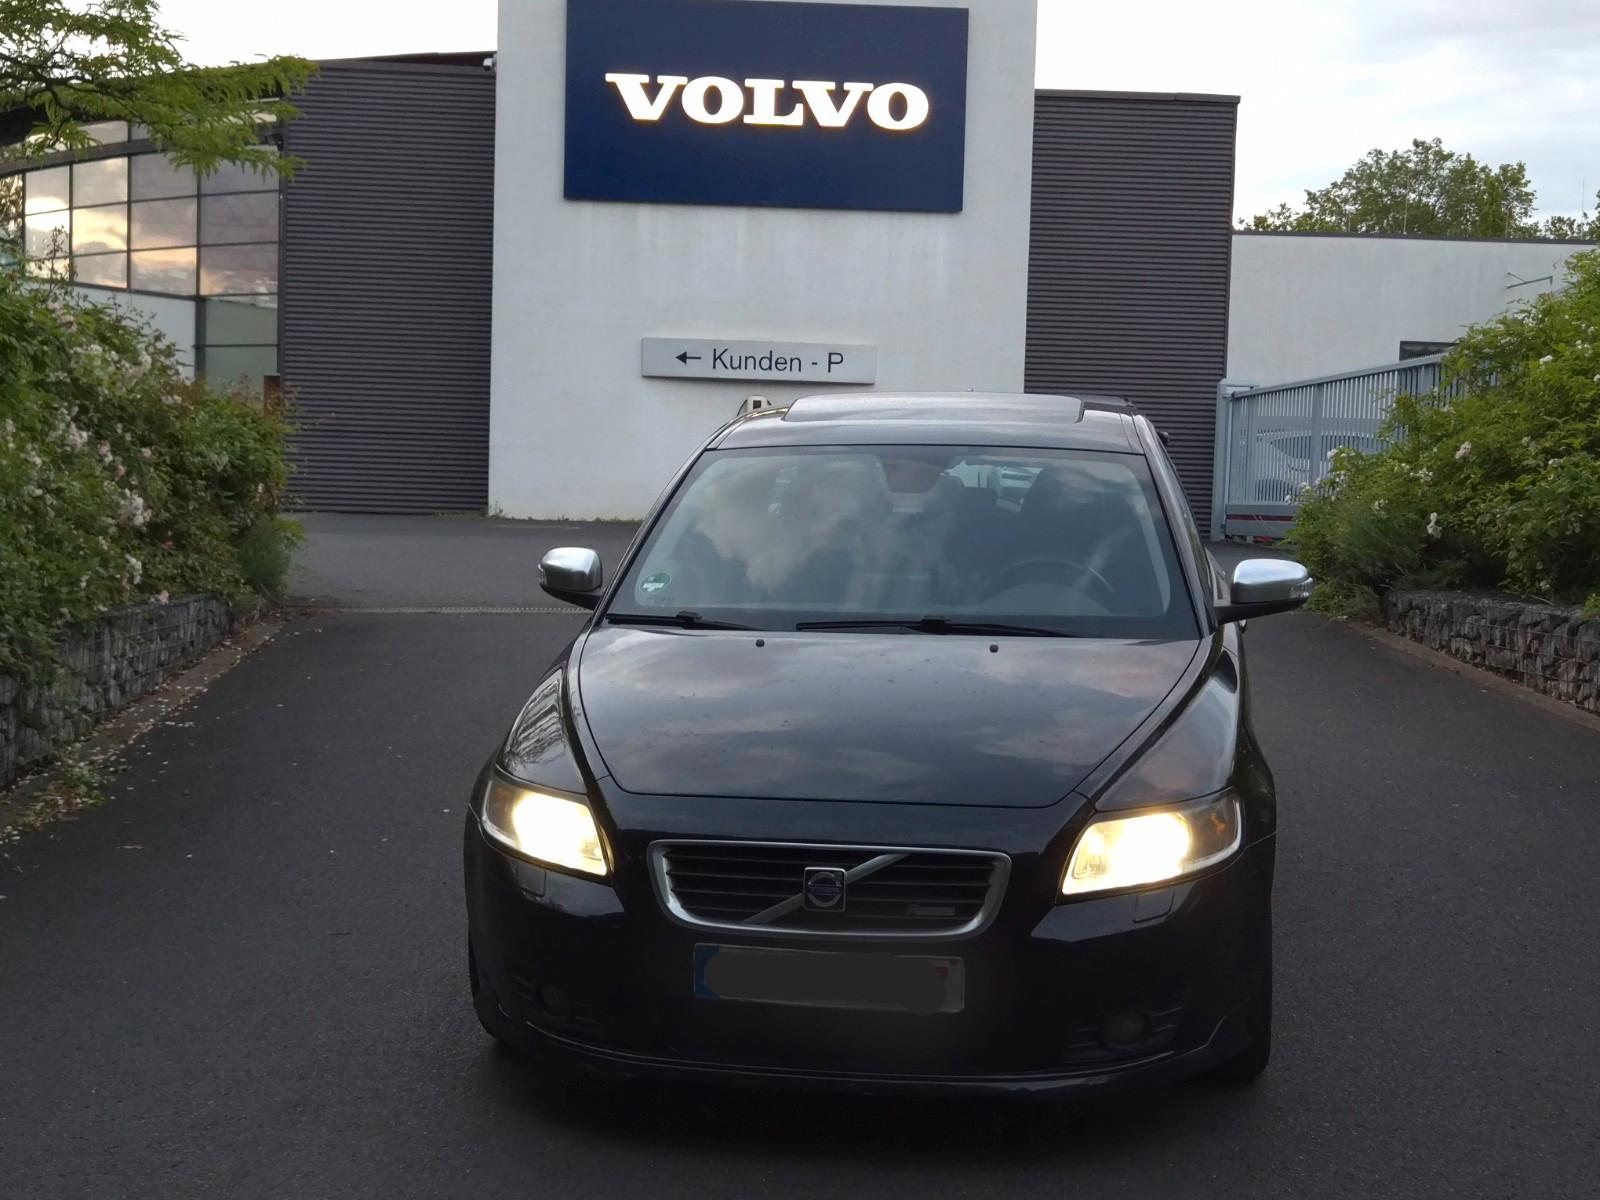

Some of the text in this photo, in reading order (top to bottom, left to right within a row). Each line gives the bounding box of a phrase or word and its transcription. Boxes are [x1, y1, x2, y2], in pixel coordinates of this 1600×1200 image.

[605, 72, 930, 131] VOLVO
[712, 348, 802, 372] Kunden
[827, 352, 844, 373] P
